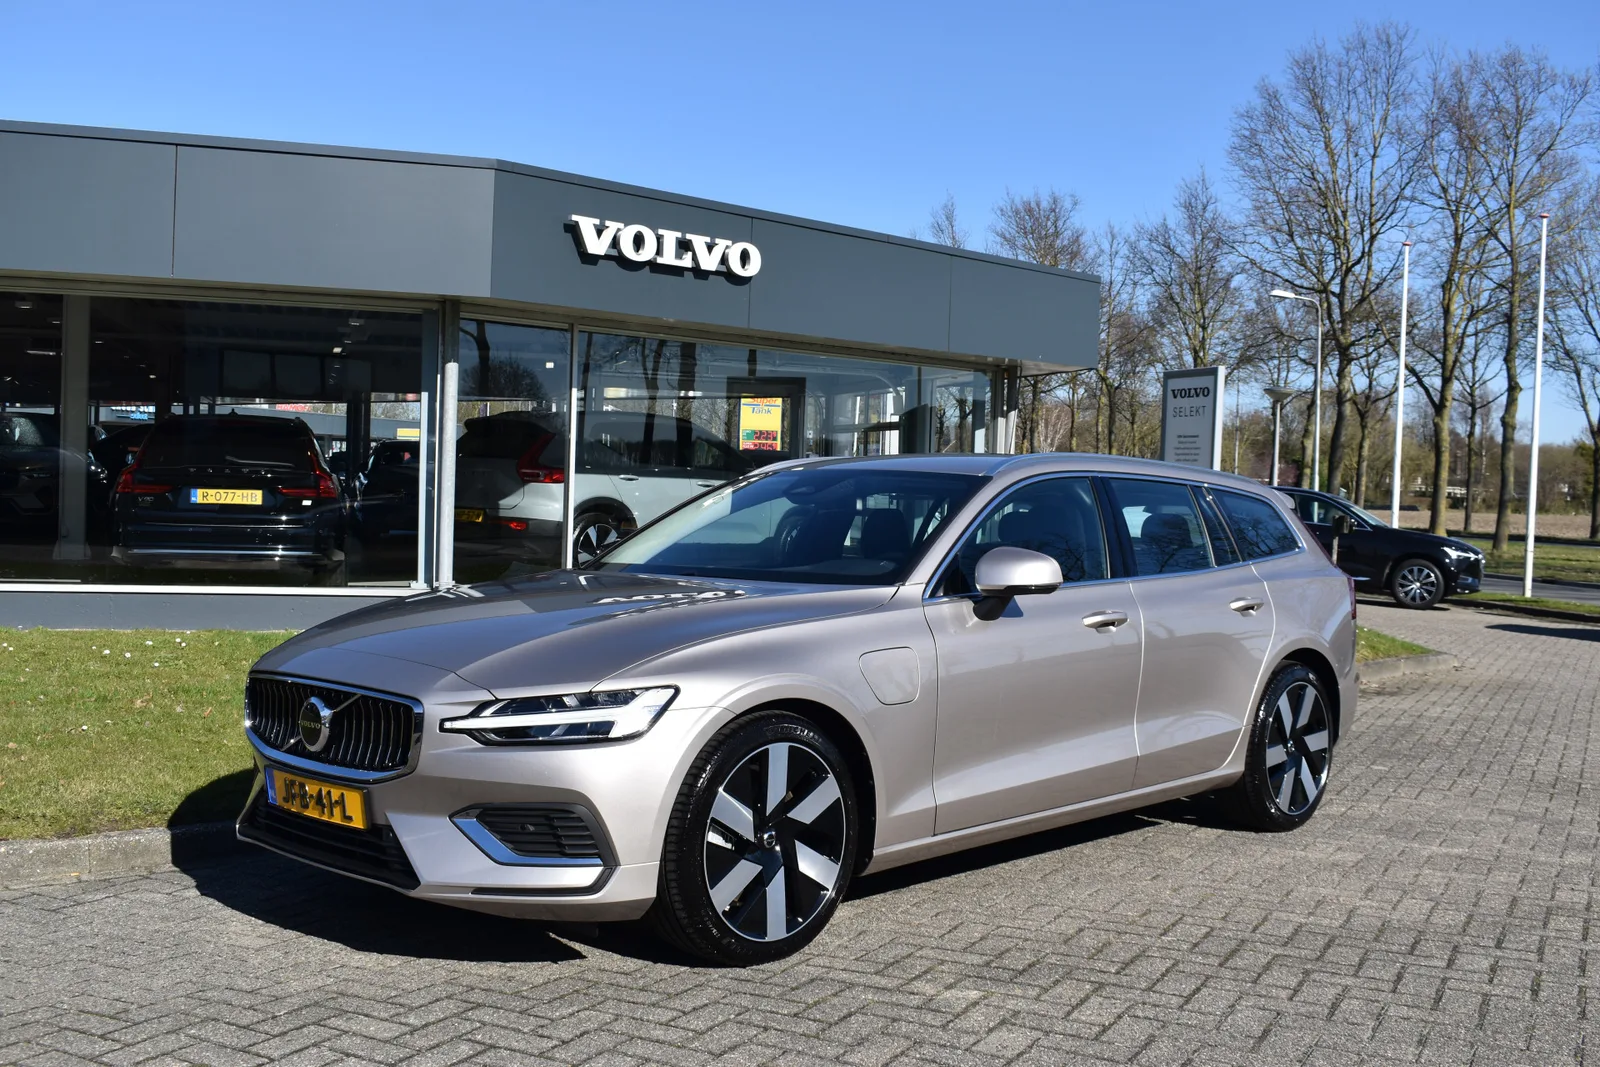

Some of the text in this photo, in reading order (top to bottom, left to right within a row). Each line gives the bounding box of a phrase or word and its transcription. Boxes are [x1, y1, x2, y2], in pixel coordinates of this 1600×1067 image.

[569, 214, 761, 277] VOLVO
[1171, 386, 1210, 399] VOLVO
[751, 407, 772, 415] Tank
[1172, 405, 1207, 418] SELEKT
[201, 491, 258, 503] R-077-HB
[300, 720, 321, 729] VOLVO
[282, 776, 354, 822] JFB-41-L
